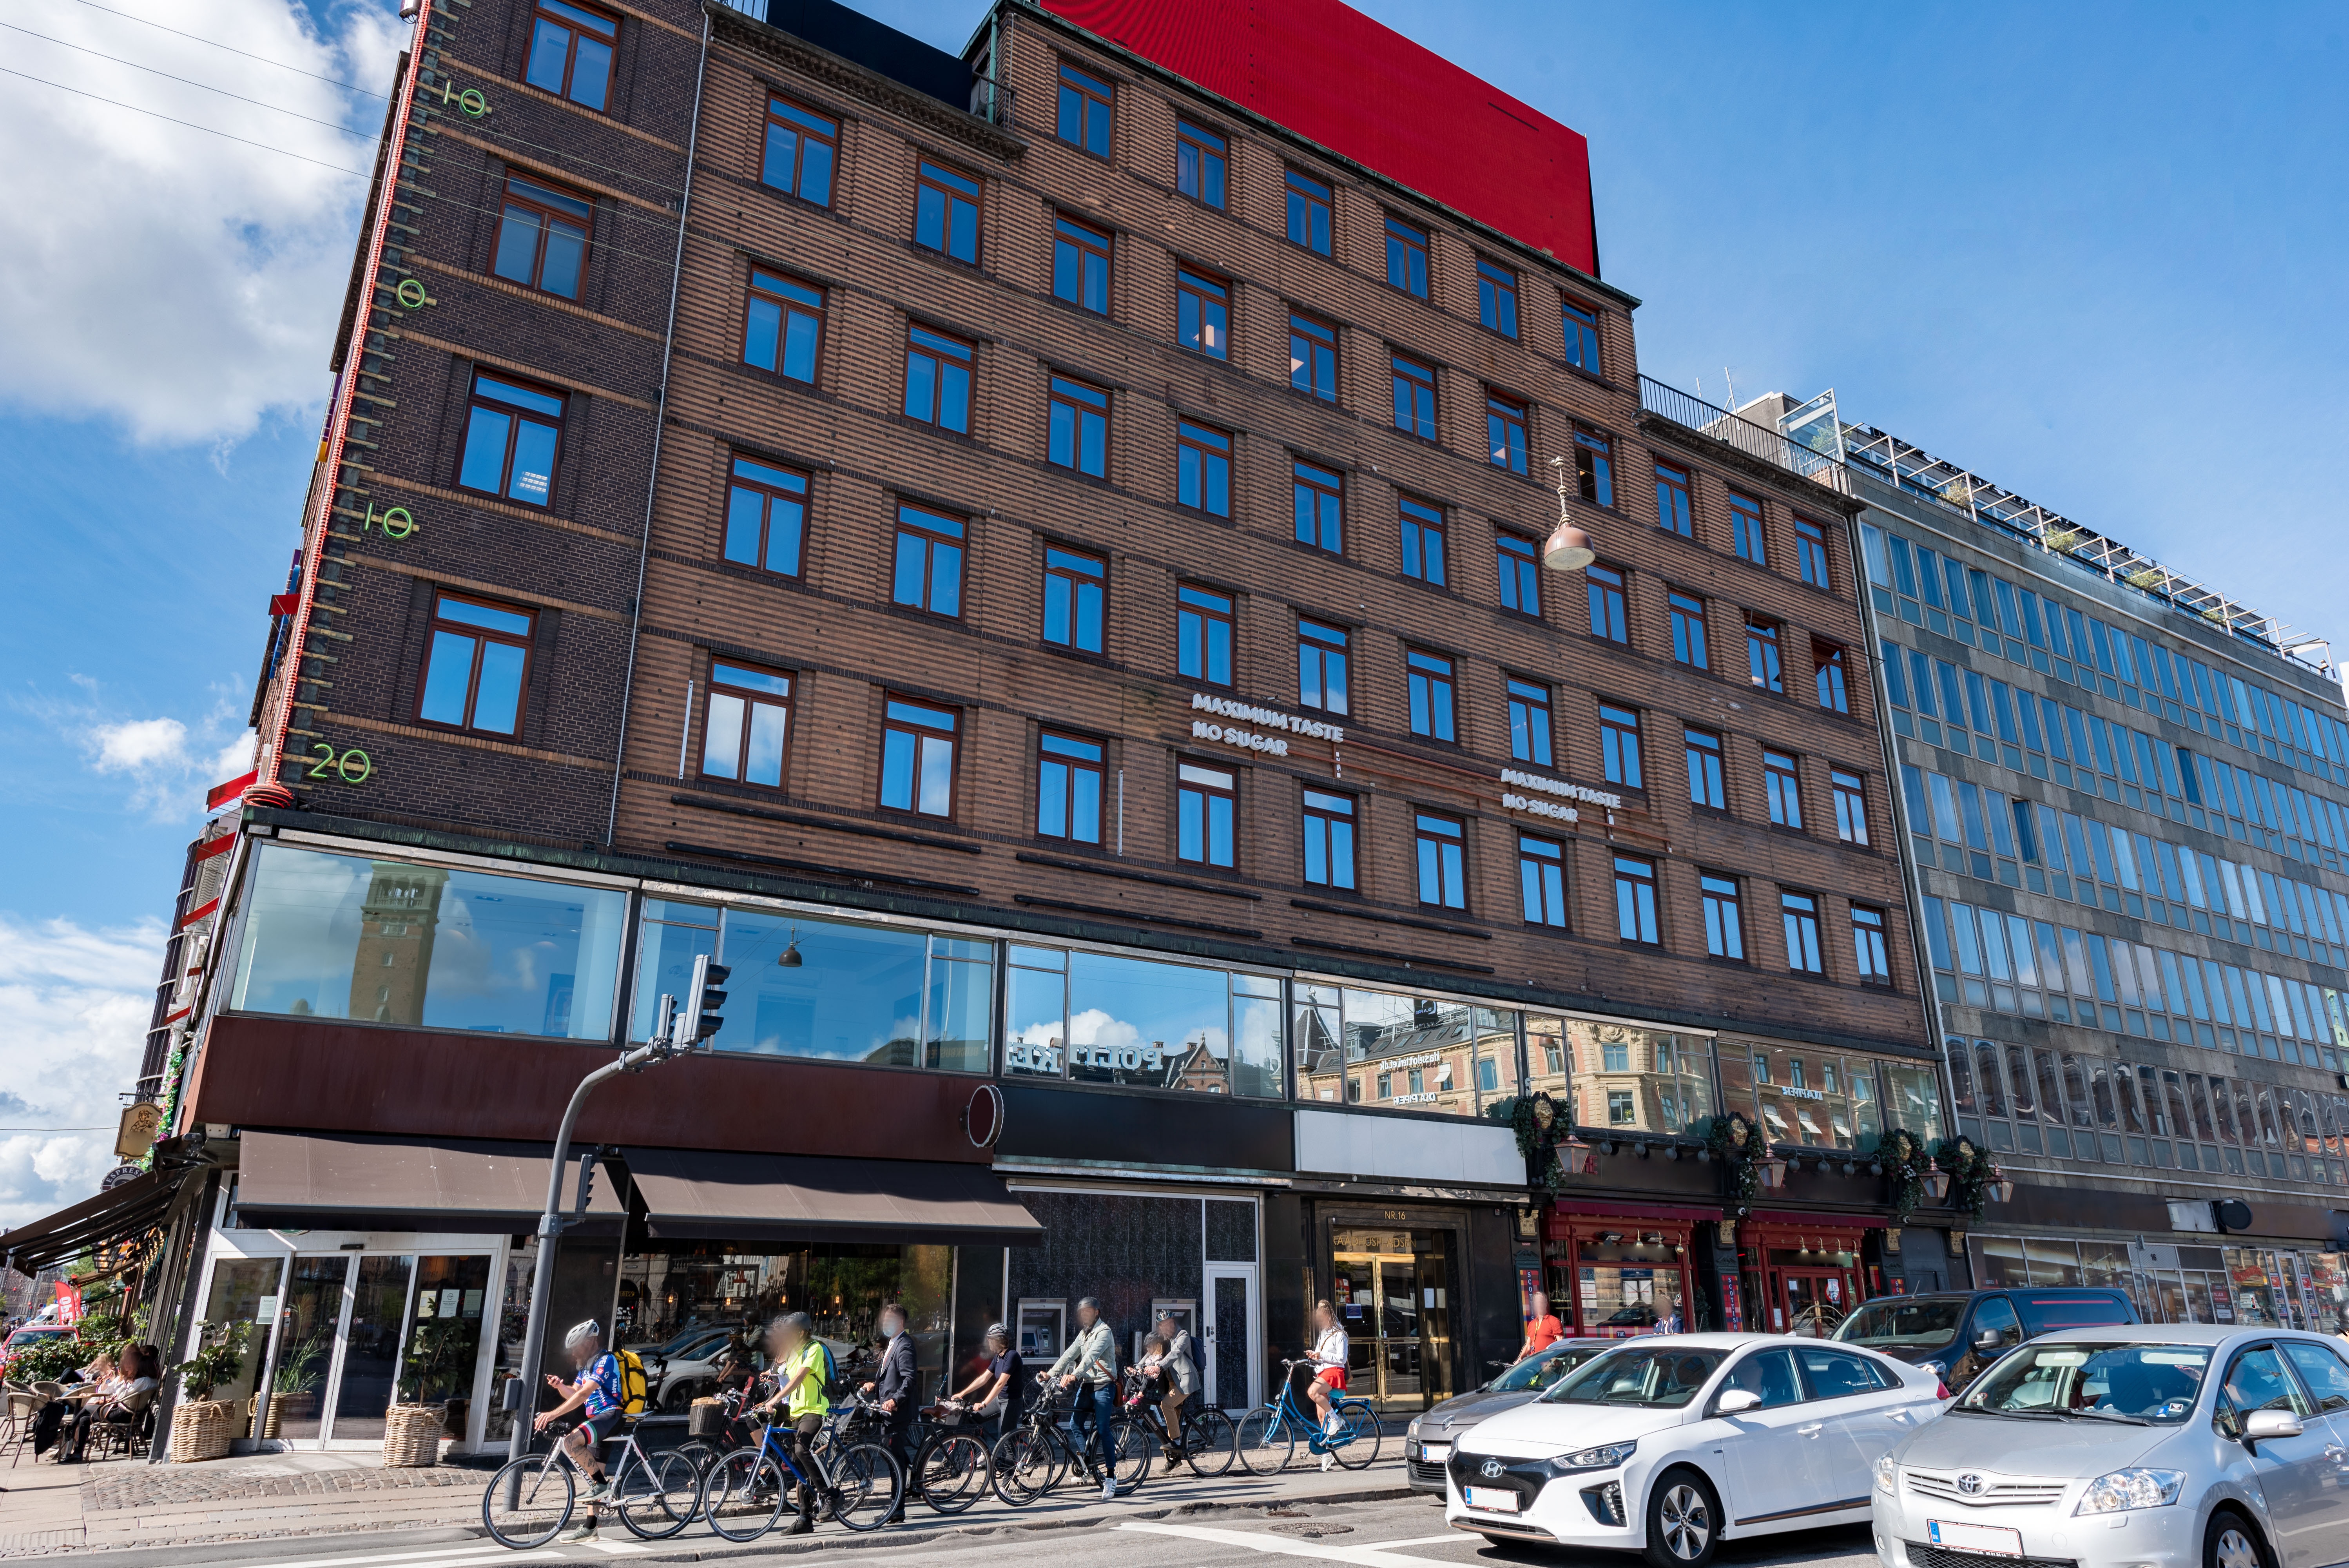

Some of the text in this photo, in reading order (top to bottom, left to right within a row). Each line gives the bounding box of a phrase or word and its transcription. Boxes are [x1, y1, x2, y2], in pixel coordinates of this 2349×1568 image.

[443, 80, 486, 119] 10
[397, 279, 426, 310] 0
[363, 500, 414, 540] 10
[1193, 693, 1343, 743] MAXIMUM TASTE
[1193, 721, 1288, 756] NO SUGAR
[310, 744, 371, 784] 20
[1501, 768, 1621, 809] MAXIMUM TASTE
[1503, 793, 1578, 823] NO SUGAR
[106, 1167, 144, 1183] ESPRESS
[1728, 1277, 1737, 1330] SCOTTISH
[1049, 1425, 1064, 1443] winther
